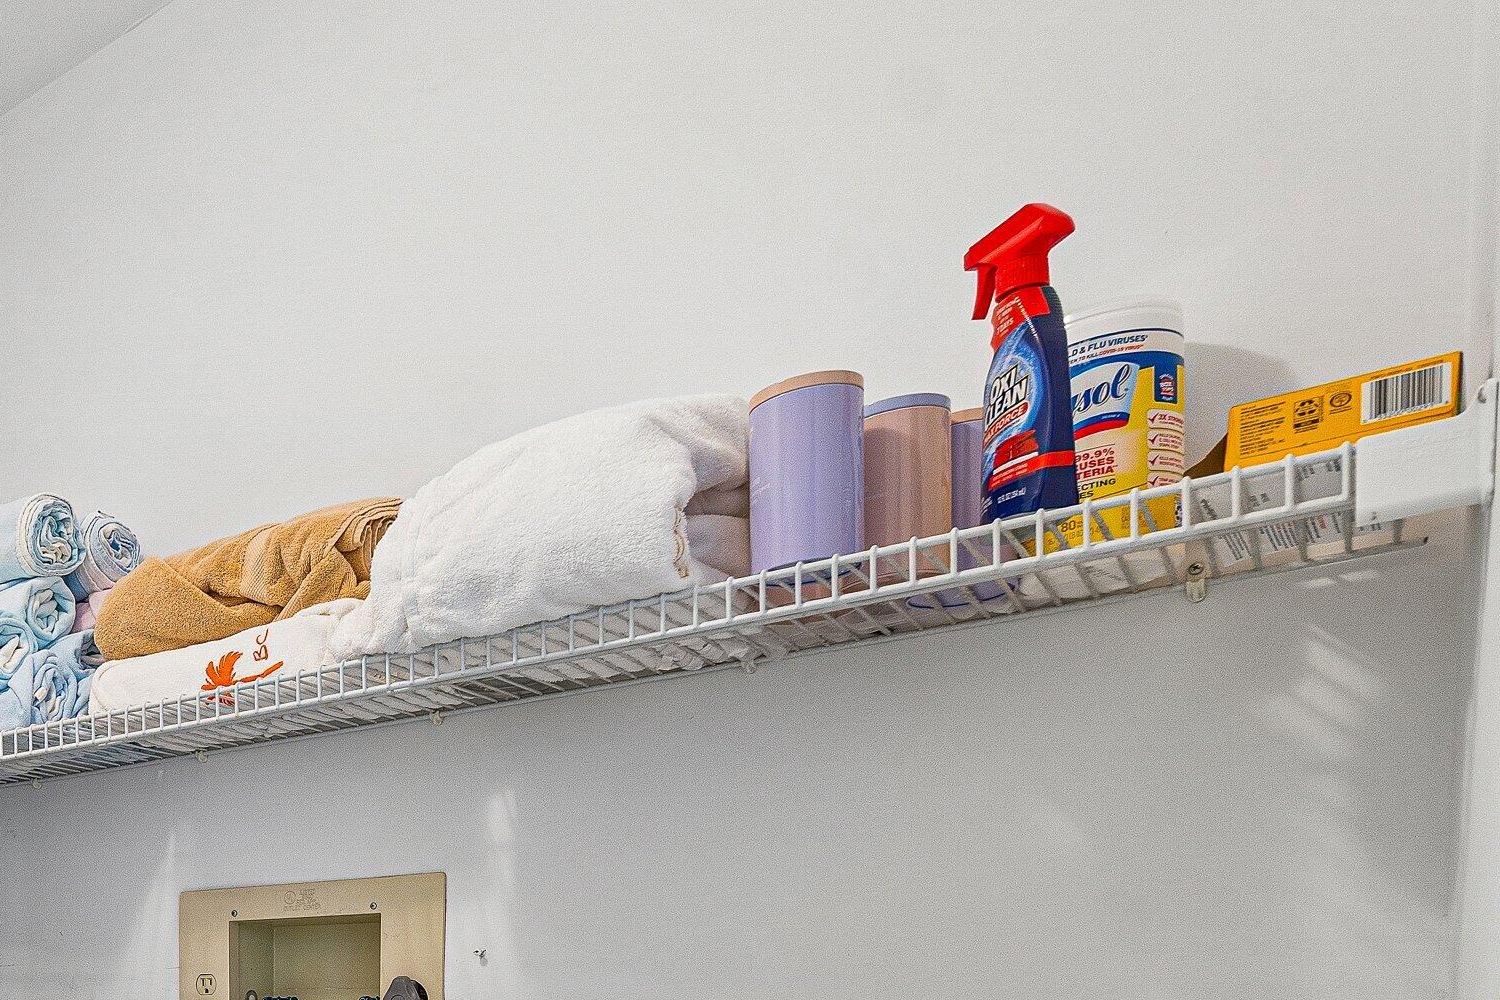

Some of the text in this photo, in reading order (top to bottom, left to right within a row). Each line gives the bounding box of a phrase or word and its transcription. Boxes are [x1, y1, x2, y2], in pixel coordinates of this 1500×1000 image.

[1087, 340, 1107, 352] FLU
[989, 364, 1018, 405] OXI
[1070, 364, 1130, 413] sol
[1076, 456, 1115, 470] USES
[1076, 466, 1115, 480] TERIA
[1060, 520, 1076, 533] 80
